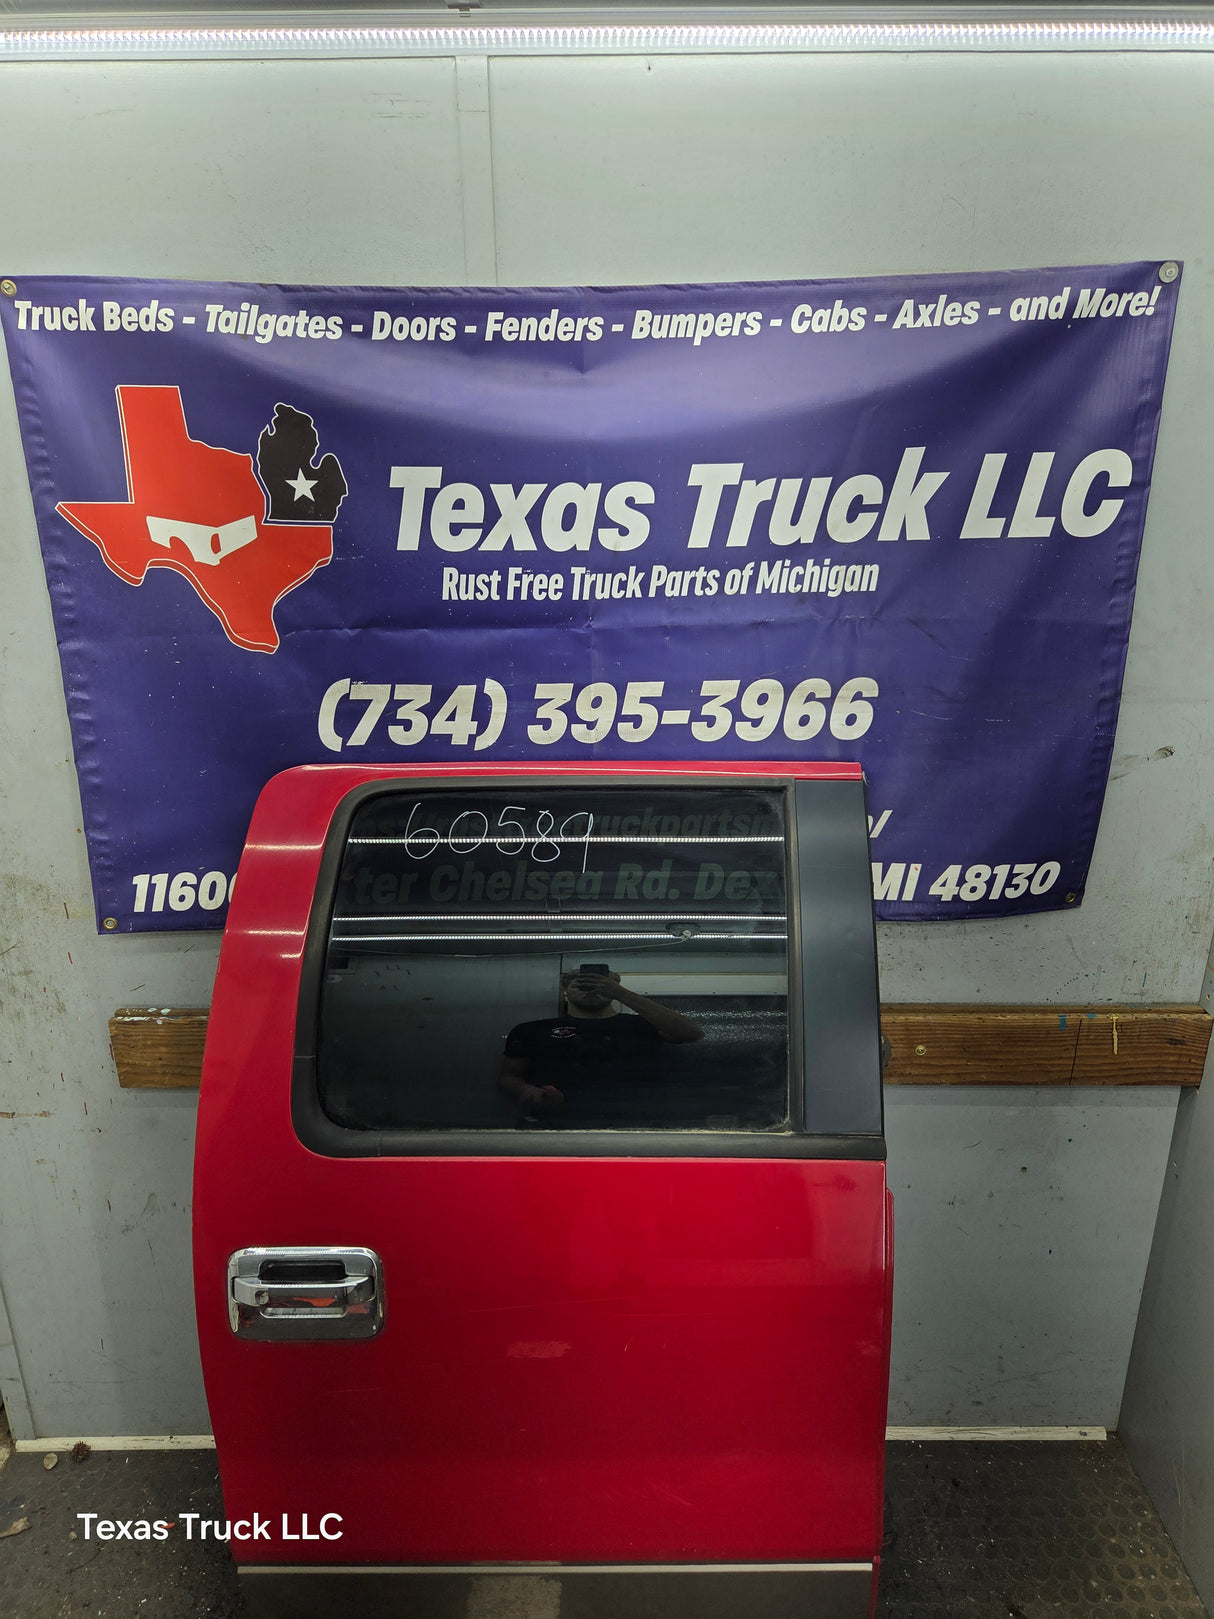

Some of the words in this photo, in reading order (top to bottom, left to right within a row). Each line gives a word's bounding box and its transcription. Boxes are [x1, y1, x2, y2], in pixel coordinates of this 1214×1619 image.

[14, 298, 97, 332] Truck
[102, 299, 176, 333] Beds
[204, 301, 344, 345] Tailgates
[371, 310, 457, 342] Doors
[484, 308, 605, 342] Fenders
[631, 309, 763, 345] Bumpers
[790, 299, 868, 334] Cabs
[891, 294, 981, 330] Axles
[1009, 286, 1072, 322] and
[1072, 285, 1163, 319] More!
[389, 466, 656, 553] Texas
[686, 446, 951, 549] Truck
[959, 448, 1133, 540] LLC
[442, 566, 502, 601] Rust
[506, 566, 564, 601] Free
[570, 565, 645, 600] Truck
[648, 564, 721, 598] Parts
[723, 561, 755, 596] of
[755, 558, 880, 598] Michigan
[317, 677, 508, 753] (734)
[527, 676, 879, 745] 395-3966
[404, 802, 594, 874] 60589
[132, 870, 238, 913] 1160
[429, 860, 604, 903] Chelsea
[613, 859, 681, 901] Rd.
[871, 862, 923, 901] MI
[928, 861, 1061, 902] 48130
